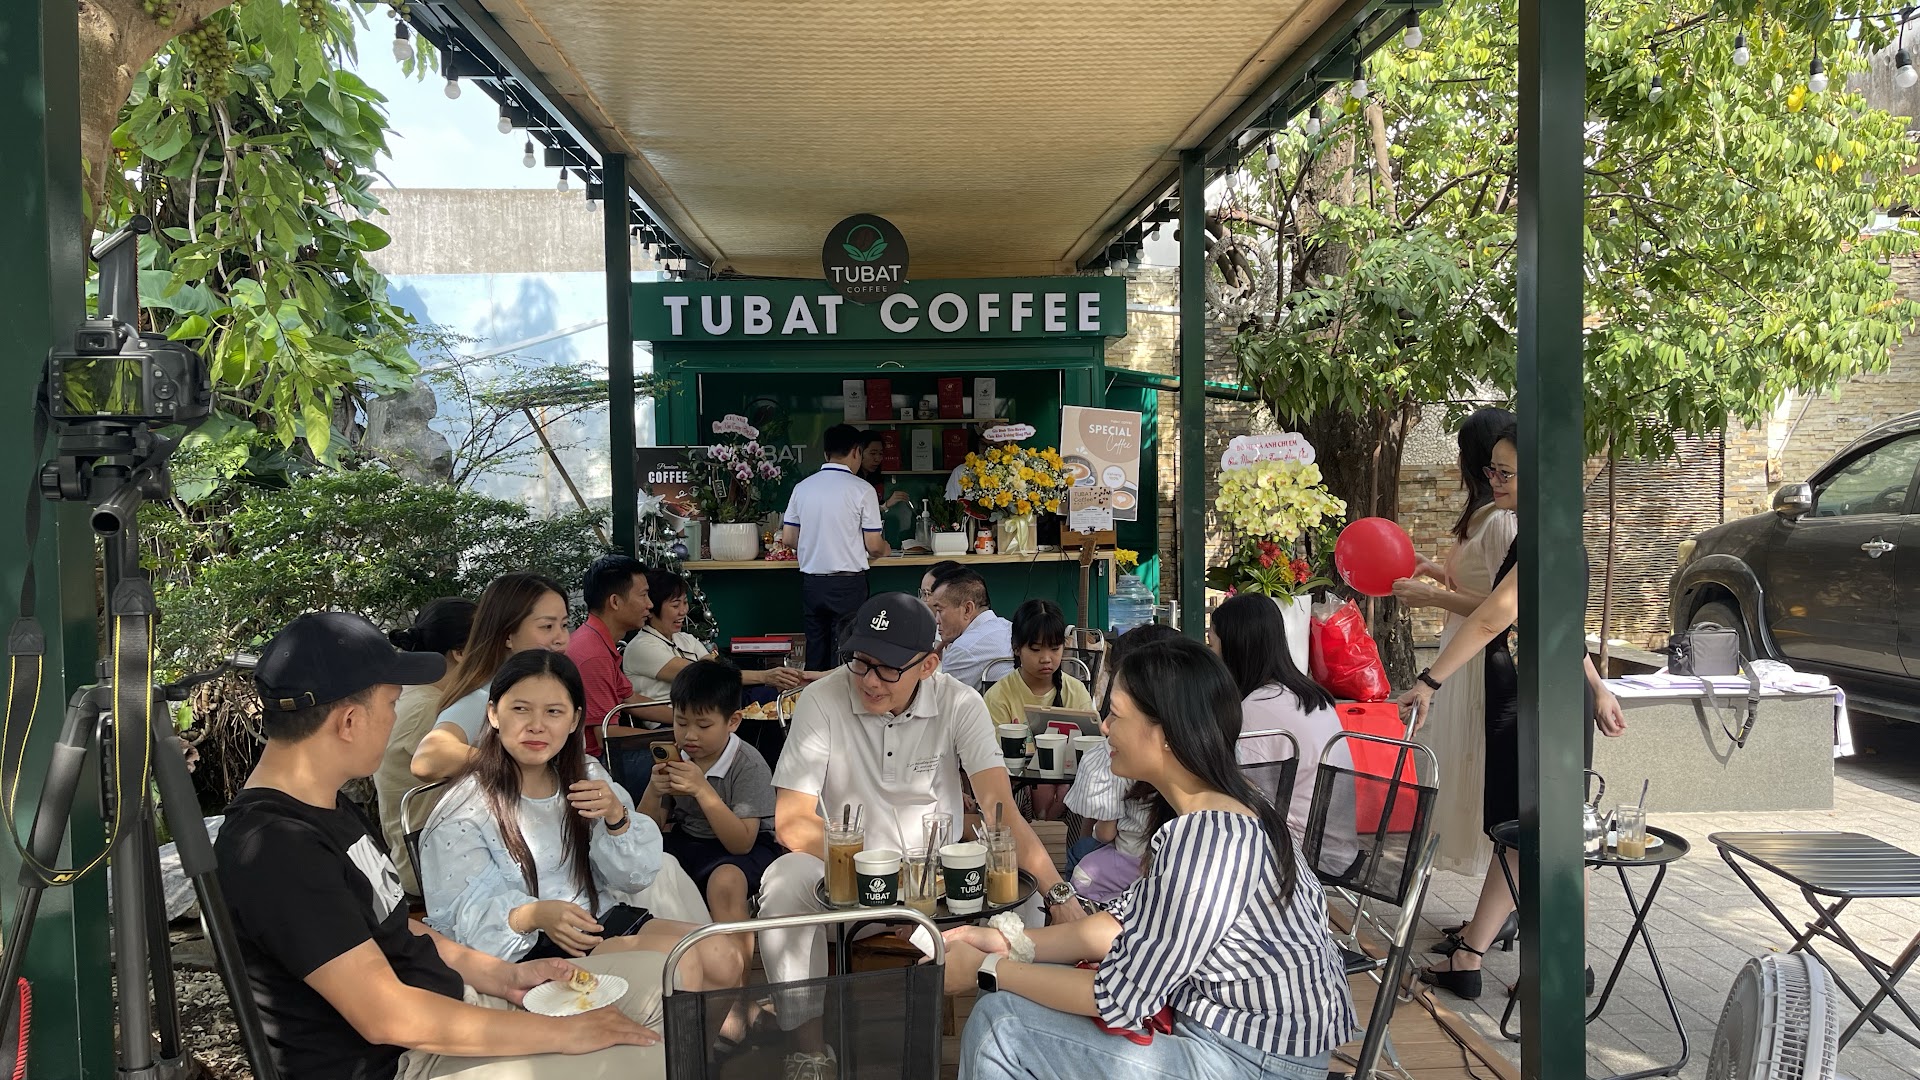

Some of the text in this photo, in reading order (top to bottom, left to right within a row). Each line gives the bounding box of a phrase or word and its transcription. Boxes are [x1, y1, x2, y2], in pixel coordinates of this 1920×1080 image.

[831, 265, 901, 283] TUBAT
[663, 292, 1100, 336] TUBAT COFFEE
[1089, 424, 1132, 437] SPECIAL
[1106, 435, 1132, 455] Coffee
[648, 471, 688, 484] COFFEE
[960, 884, 983, 894] TUBAT
[865, 892, 890, 900] TUBAT
